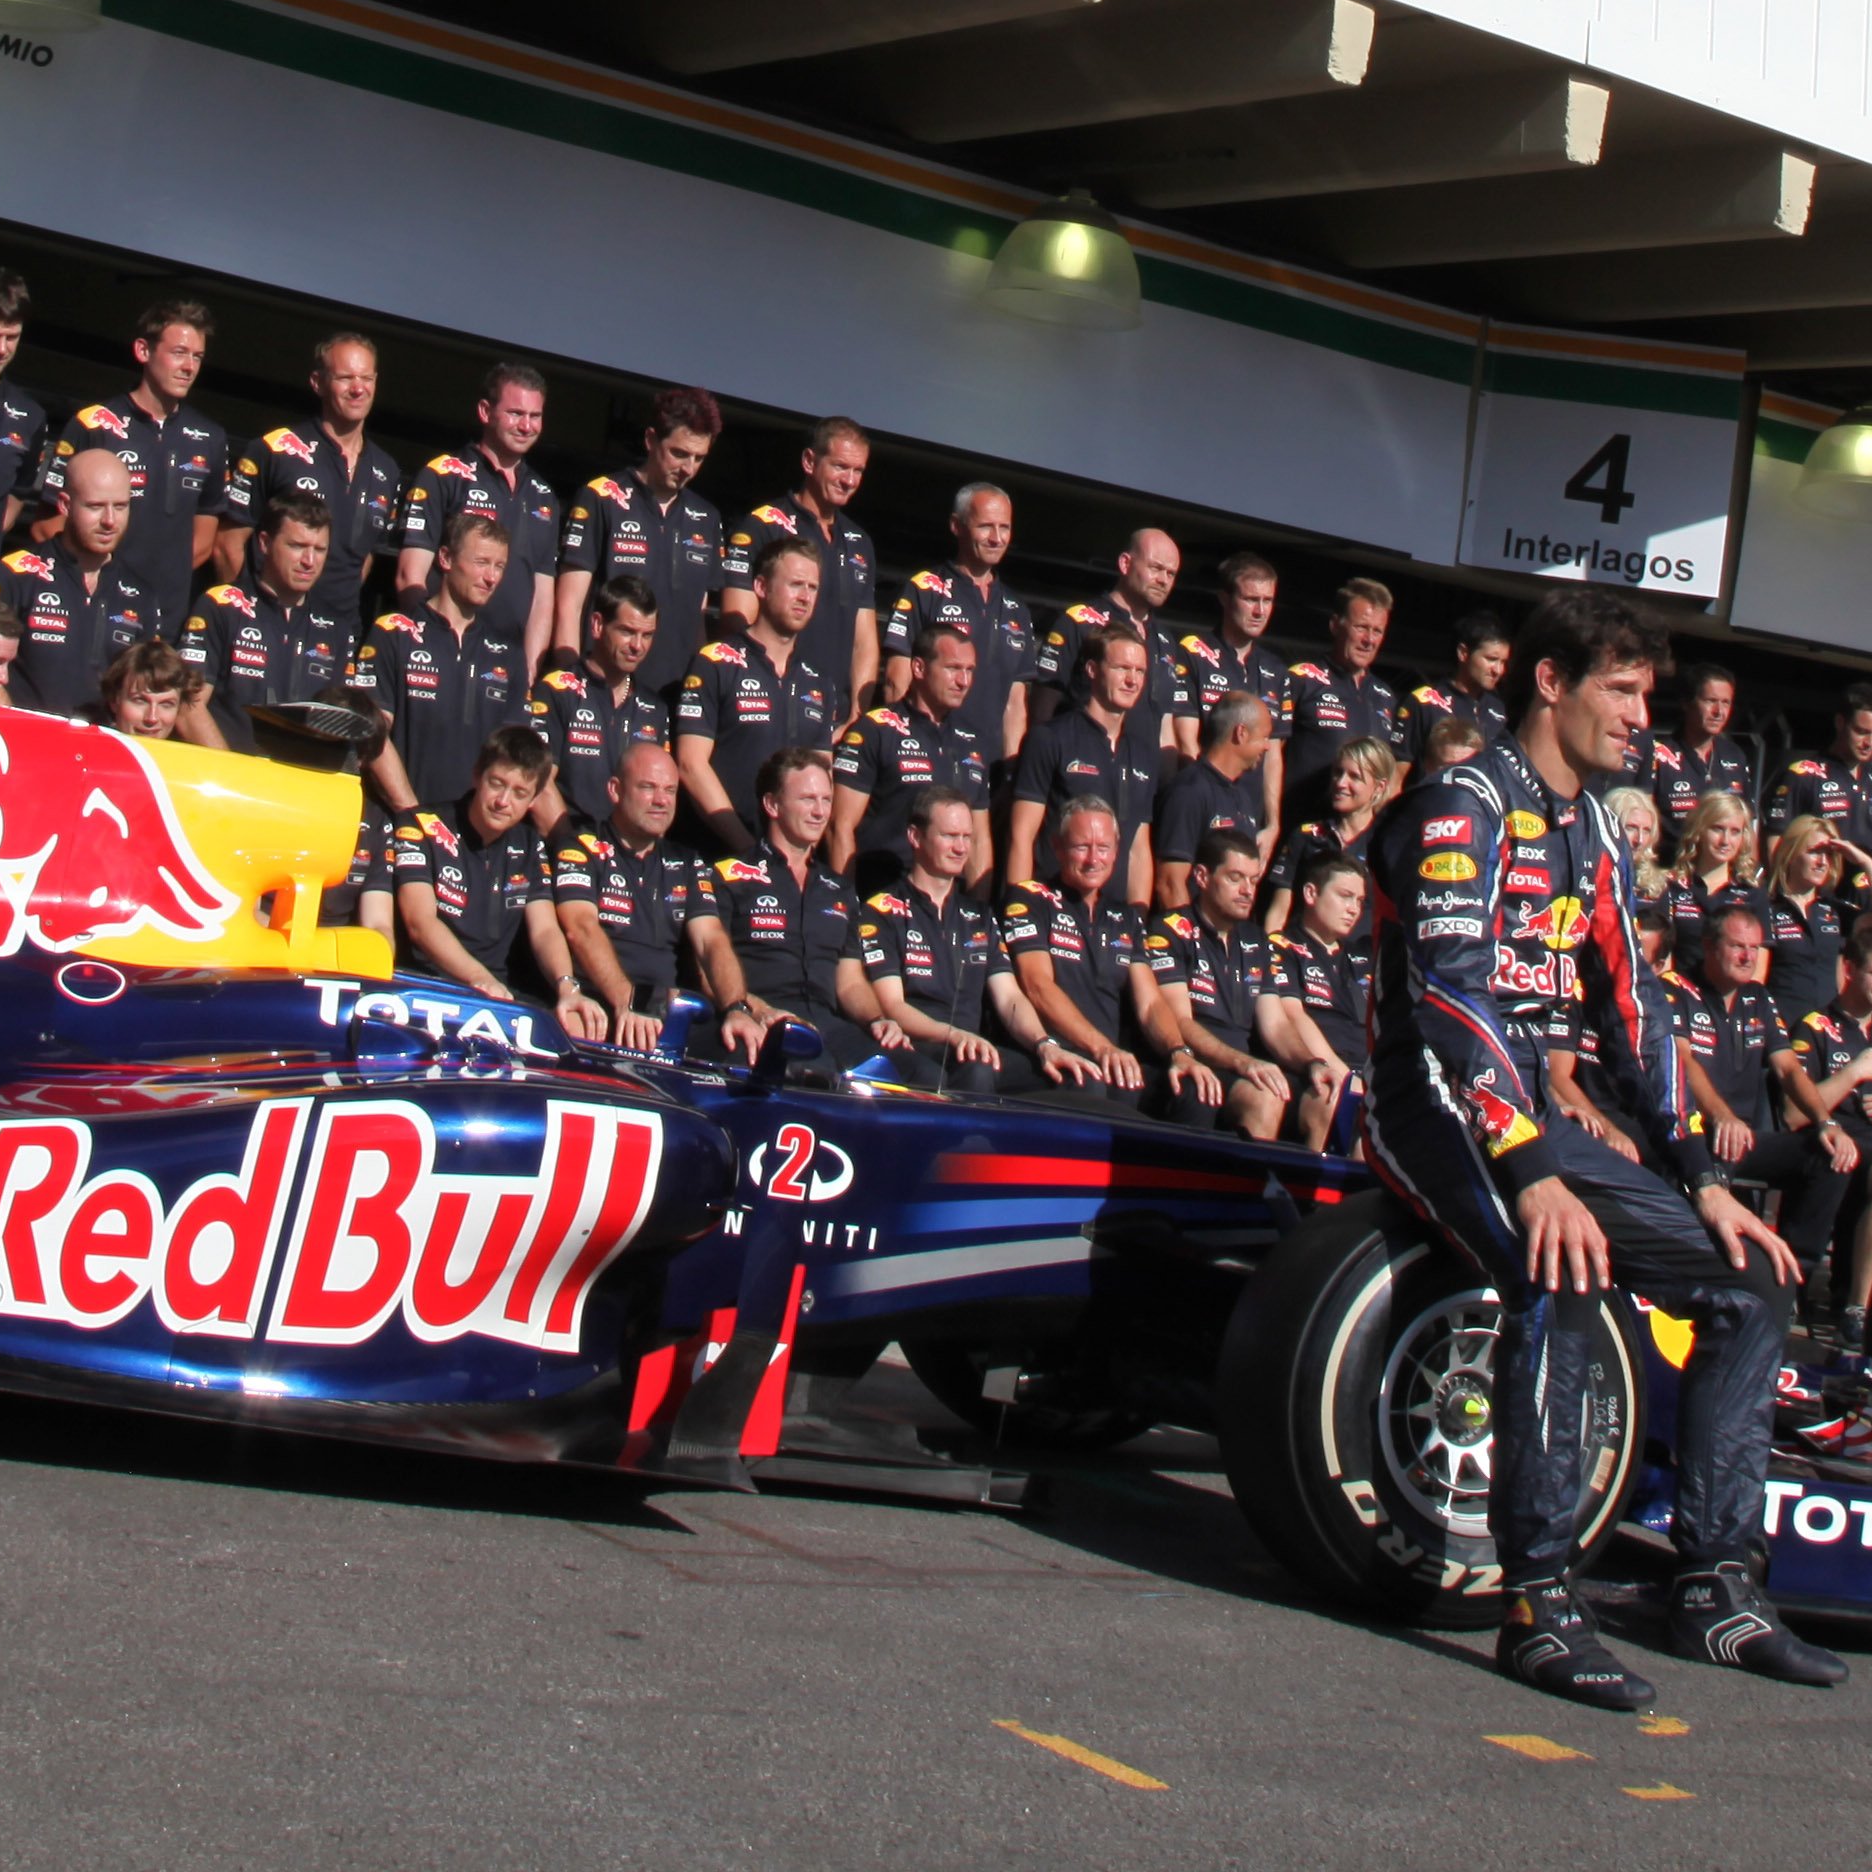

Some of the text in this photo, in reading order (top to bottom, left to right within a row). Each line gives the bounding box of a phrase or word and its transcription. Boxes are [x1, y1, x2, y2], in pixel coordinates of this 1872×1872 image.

[1564, 434, 1636, 525] 4
[613, 533, 647, 541] INFINITI
[616, 542, 646, 552] TOTAL
[614, 556, 646, 565] GEOX
[1503, 528, 1695, 582] Interlagos
[33, 616, 67, 628] TOTAL
[31, 632, 66, 643] GEOX
[234, 650, 266, 664] TOTAL
[231, 665, 265, 678] GEOX
[406, 675, 437, 686] TOTAL
[737, 699, 769, 709] TOTAL
[739, 713, 770, 721] GEOX
[569, 722, 602, 730] INFINITI
[1318, 720, 1347, 728] GEOX
[570, 732, 600, 742] TOTAL
[569, 747, 600, 756] GEOX
[900, 760, 931, 770] TOTAL
[901, 774, 933, 782] GEOX
[1424, 819, 1465, 840] SKY
[1517, 847, 1546, 861] EOX
[1434, 863, 1472, 873] RAUCH
[1507, 871, 1546, 888] TOTAL
[437, 884, 464, 904] TOTAL
[602, 897, 630, 910] TOTAL
[1417, 890, 1483, 911] Pepe Jeans
[599, 912, 630, 925] GEOX
[752, 916, 783, 926] TOTAL
[1430, 921, 1478, 933] FXDD
[750, 931, 785, 940] GEOX
[1052, 933, 1081, 948] TOTAL
[1050, 947, 1081, 961] GEOX
[1487, 944, 1556, 997] Red
[1191, 979, 1215, 992] TOTAL
[1189, 992, 1216, 1004] GEOX
[305, 977, 561, 1060] TOTAL
[1691, 1031, 1713, 1043] TOTAL
[767, 1123, 816, 1202] 2
[266, 1099, 664, 1354] Bull
[1573, 1673, 1624, 1683] GEOX
